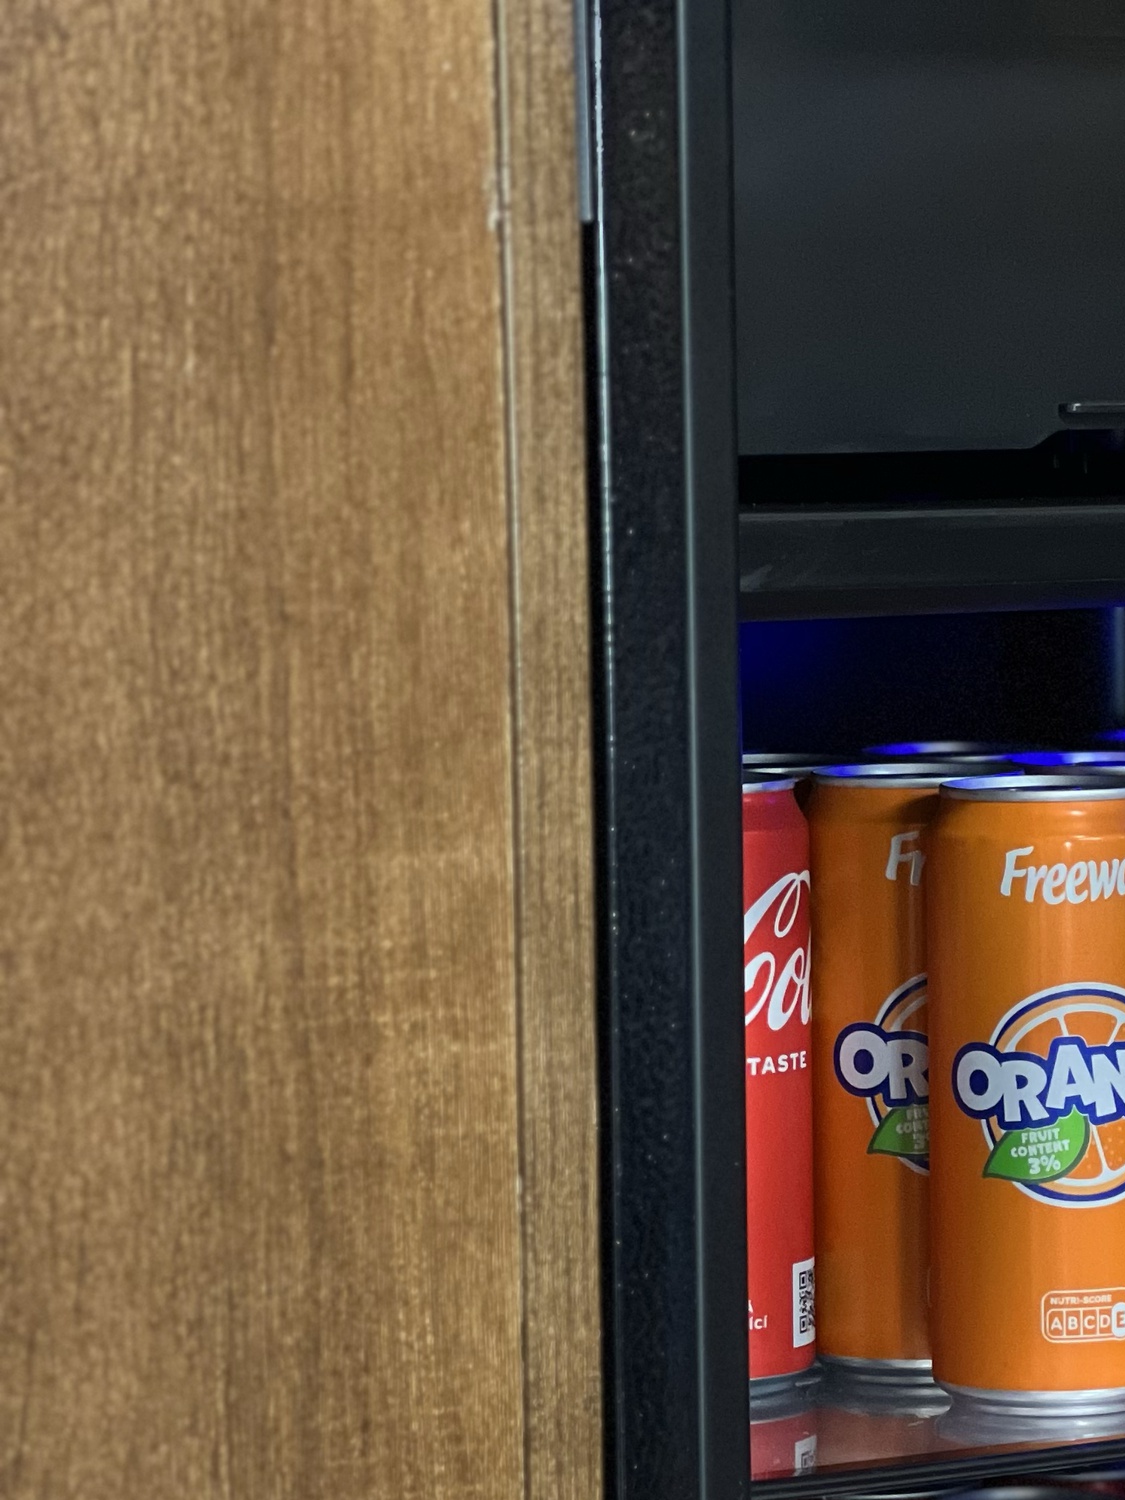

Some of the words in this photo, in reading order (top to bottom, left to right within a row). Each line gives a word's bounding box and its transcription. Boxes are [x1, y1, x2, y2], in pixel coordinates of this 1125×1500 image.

[747, 1051, 807, 1076] TASTE
[1021, 1128, 1060, 1143] FRUIT
[1010, 1139, 1070, 1158] CONTENT
[1028, 1155, 1061, 1175] 3%
[1050, 1294, 1112, 1305] NUTRI-SCORE
